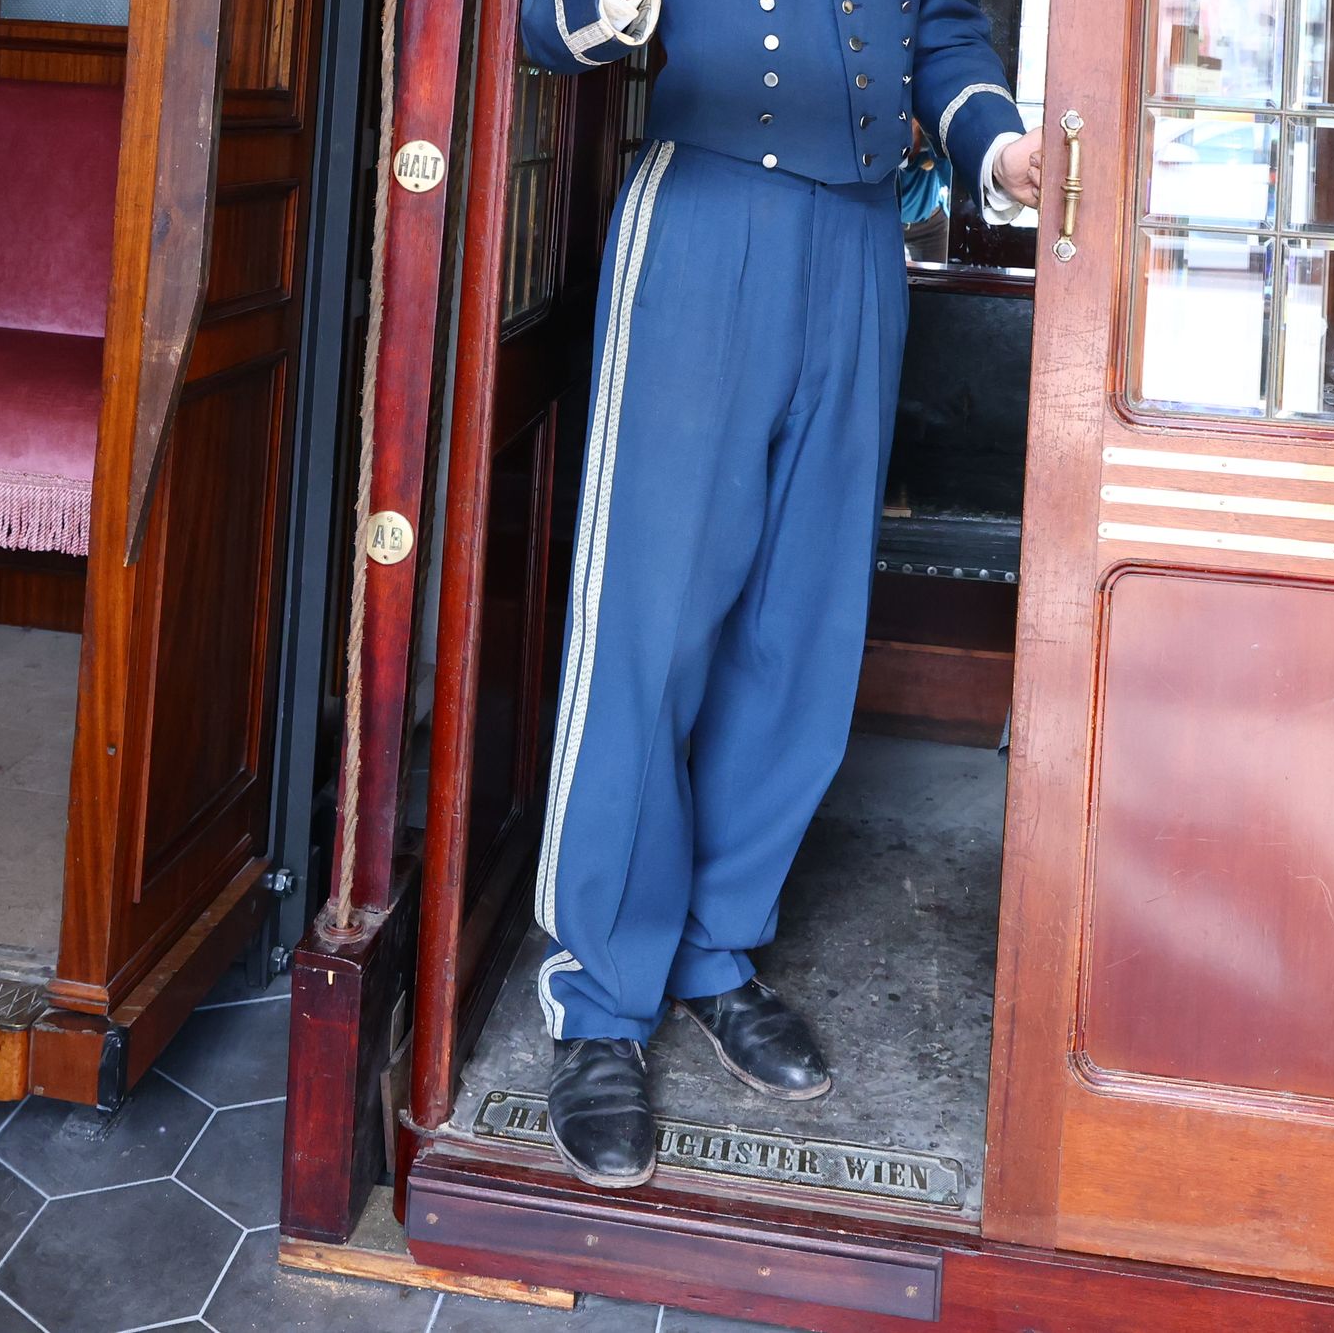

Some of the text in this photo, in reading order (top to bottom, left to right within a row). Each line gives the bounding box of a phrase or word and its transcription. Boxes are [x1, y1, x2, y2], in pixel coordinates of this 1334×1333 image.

[397, 152, 441, 181] HALT
[372, 524, 403, 550] AB
[845, 1154, 931, 1191] WIEN
